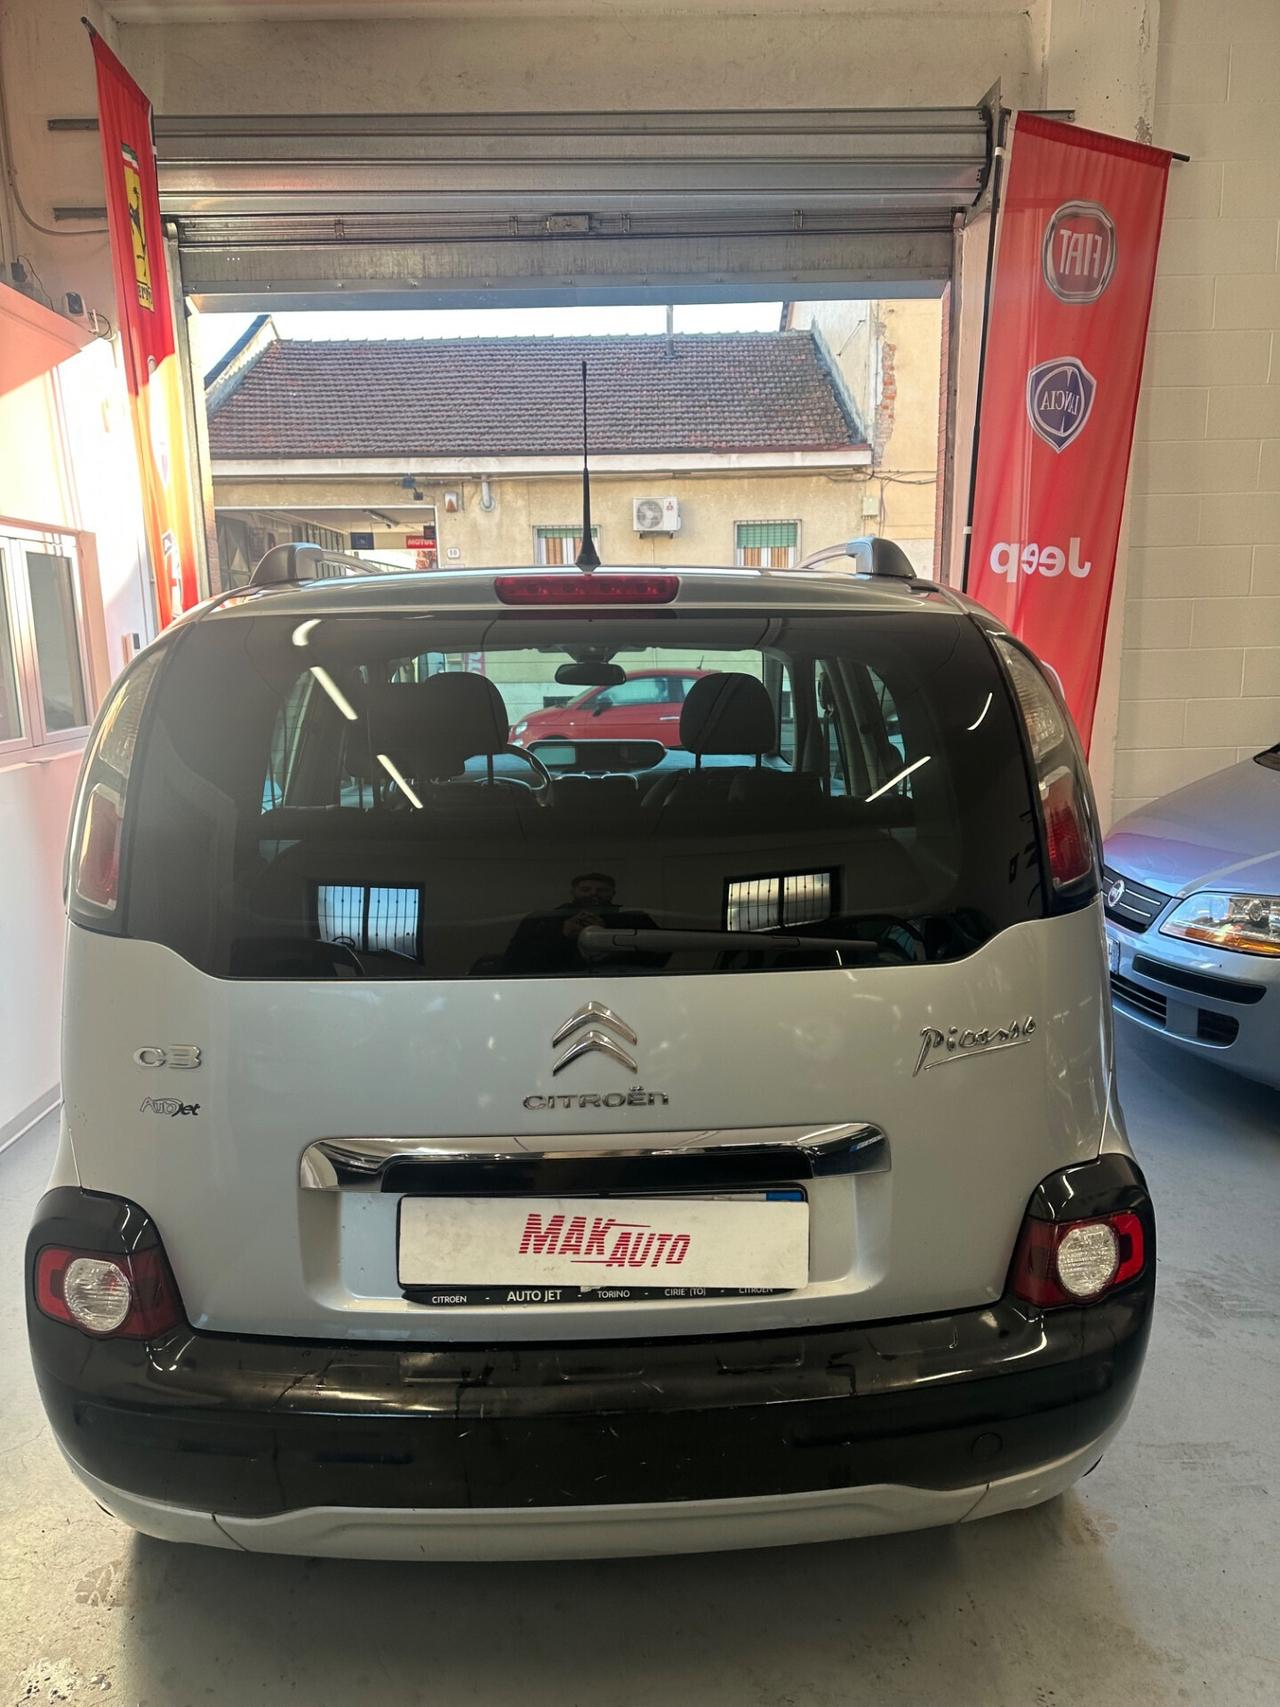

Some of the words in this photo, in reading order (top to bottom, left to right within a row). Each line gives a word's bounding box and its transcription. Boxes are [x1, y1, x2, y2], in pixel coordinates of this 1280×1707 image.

[133, 1044, 202, 1070] C3
[518, 1213, 617, 1255] MAK
[605, 1232, 691, 1268] AUTO
[506, 1290, 542, 1302] AUTO
[543, 1290, 562, 1303] JET
[597, 1289, 631, 1299] TORINO
